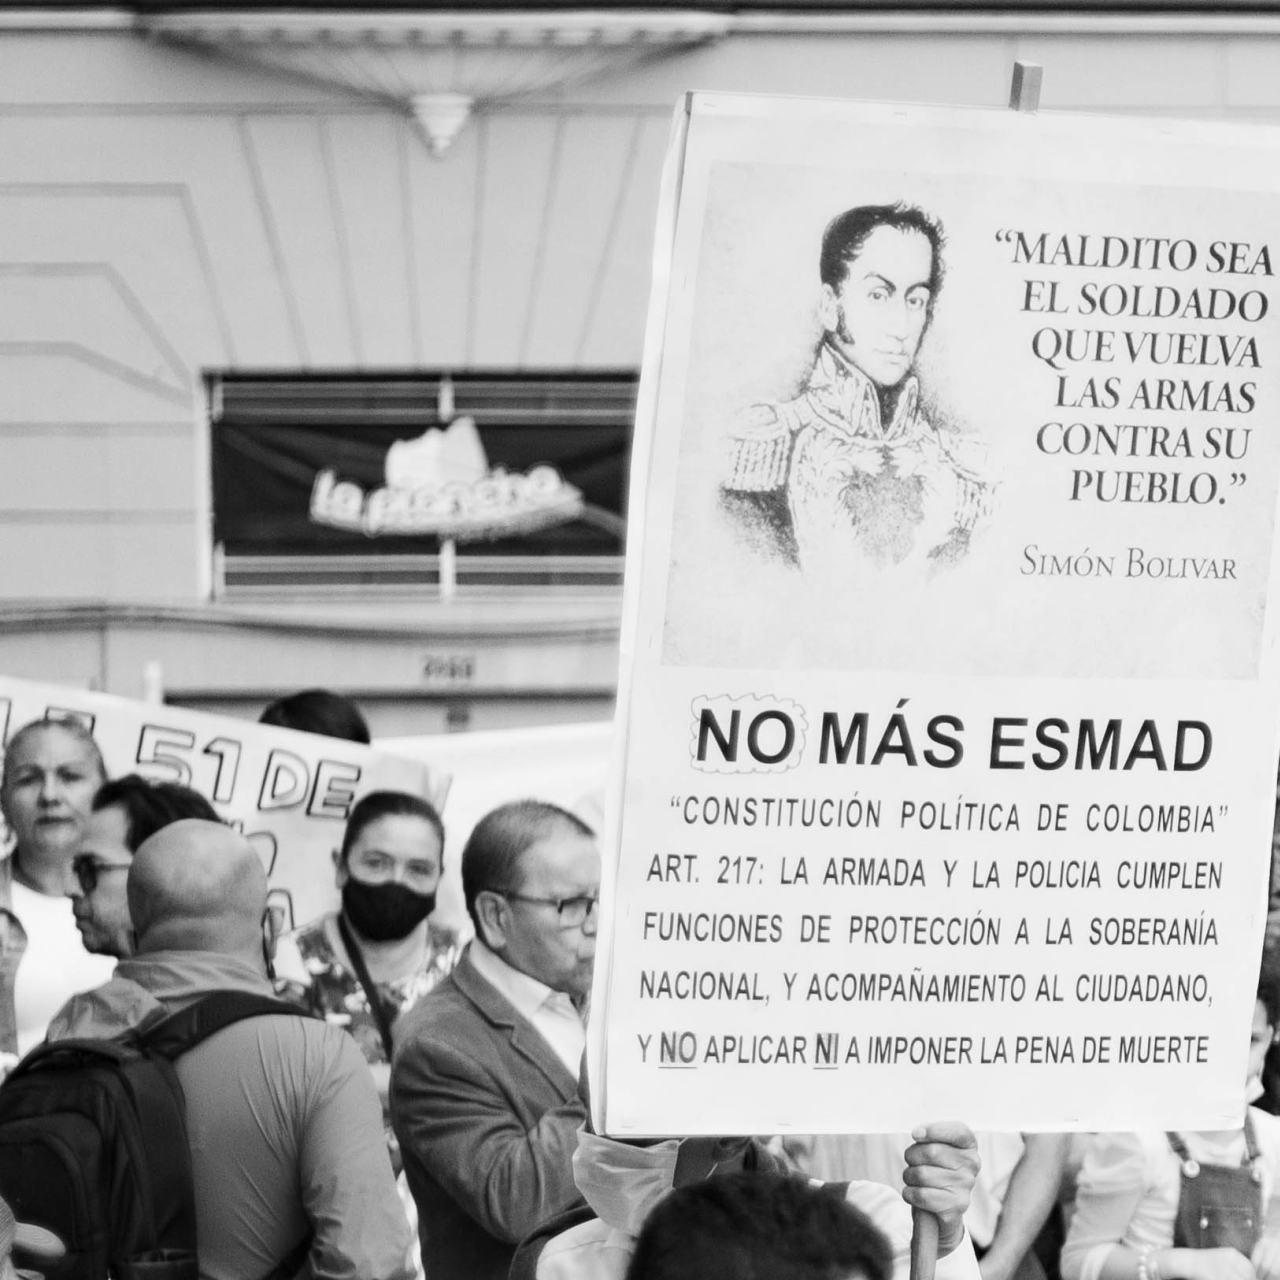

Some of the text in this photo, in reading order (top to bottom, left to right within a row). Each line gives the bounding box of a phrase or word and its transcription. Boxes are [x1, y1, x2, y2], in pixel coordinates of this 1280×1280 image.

[1206, 241, 1274, 276] SEA
[1021, 280, 1268, 322] EL SOLDADO
[1032, 328, 1262, 370] QUE VUELVA
[1056, 376, 1256, 413] LAS ARMAS
[1036, 423, 1251, 459] CONTRA SU
[697, 698, 1212, 771] NO MÁS ESMAD
[257, 747, 362, 820] DE
[901, 795, 1019, 831] POLÍTICA
[1037, 804, 1069, 831] DE
[647, 854, 1222, 889] ART. 217: LA ARMADA Y LA POLICIA CUMPLEN
[644, 910, 1218, 945] FUNCIONES DE PROTECCIÓN A LA SOBERANÍA
[640, 968, 1212, 1007] NACIONAL, Y ACOMPAÑAMIENTO AL CIUDADANO,
[637, 1032, 1209, 1064] Y NO APLICAR NI A IMPONER LA PENA DE MUERTE
